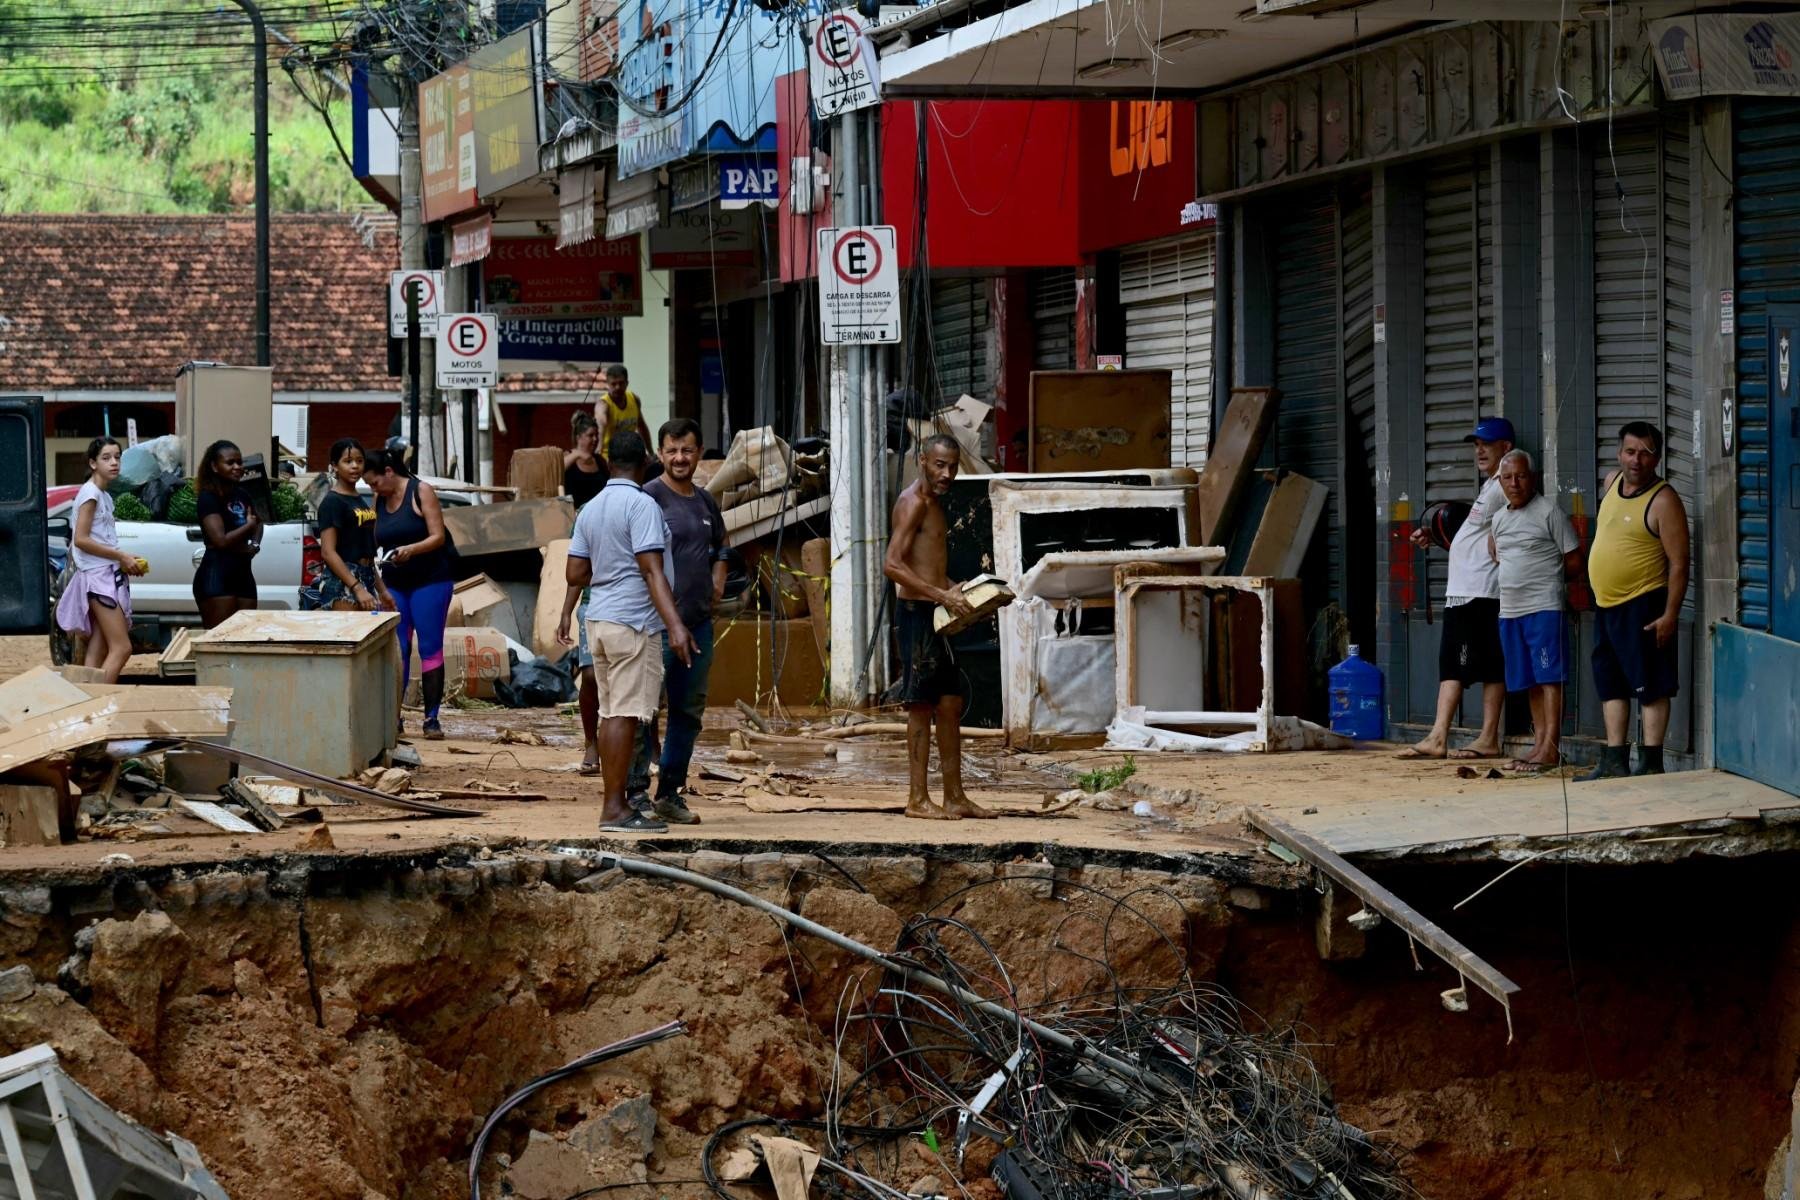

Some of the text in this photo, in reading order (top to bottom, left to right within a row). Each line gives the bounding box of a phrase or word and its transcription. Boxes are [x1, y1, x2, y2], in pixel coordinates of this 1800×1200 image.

[827, 25, 851, 58] E
[828, 69, 865, 88] MOTOS
[726, 168, 778, 194] PAP
[848, 242, 867, 274] E
[856, 291, 892, 299] DESCARGA
[460, 325, 474, 348] E
[507, 332, 553, 346] Graça
[558, 334, 575, 345] de
[580, 334, 616, 345] Deus
[836, 328, 875, 341] TÉRMINO
[451, 361, 482, 369] MOTOS
[448, 376, 478, 385] TÉRMINO
